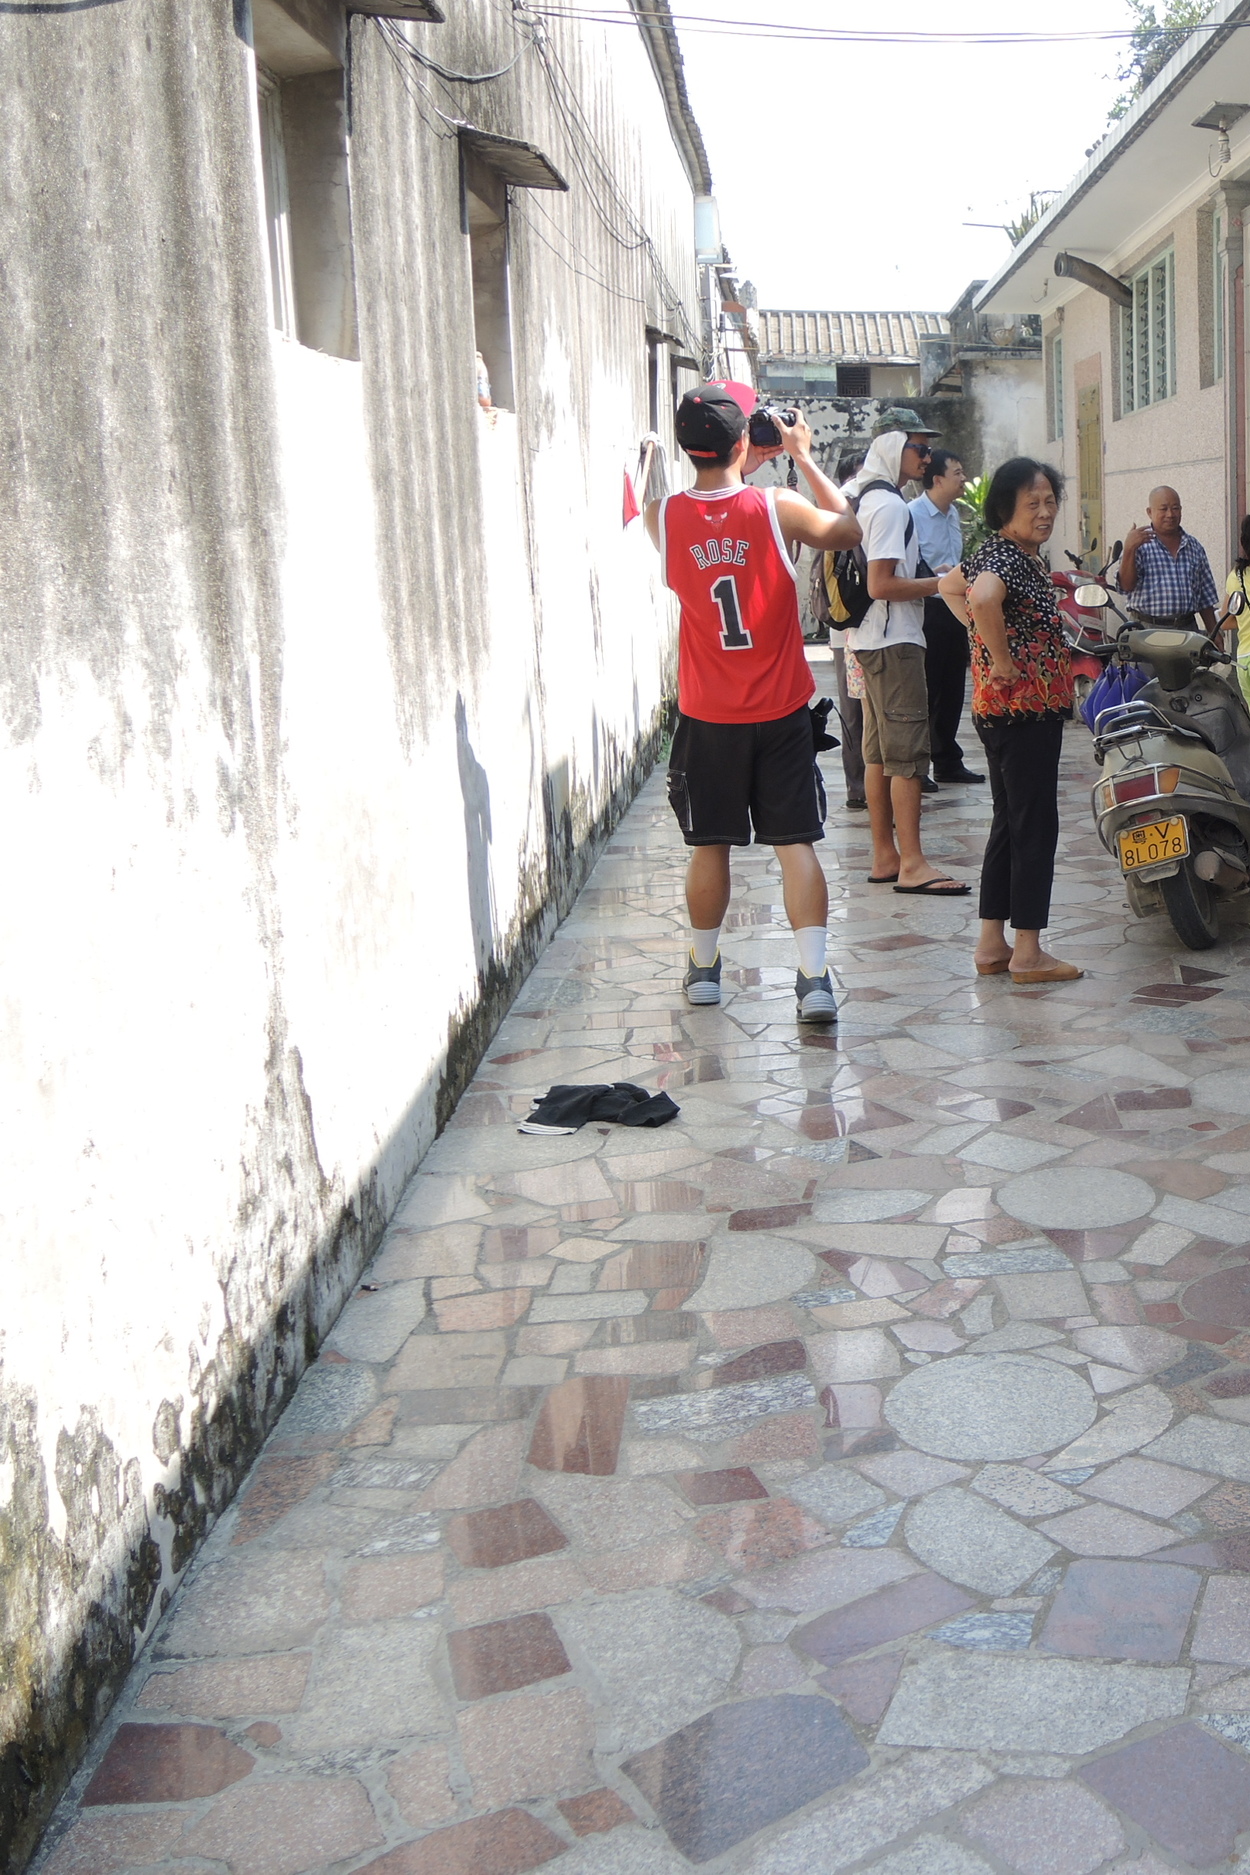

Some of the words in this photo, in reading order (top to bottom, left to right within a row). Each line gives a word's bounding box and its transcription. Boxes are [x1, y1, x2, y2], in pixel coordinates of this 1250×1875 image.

[689, 537, 750, 570] ROSE
[709, 574, 753, 650] 1
[1124, 836, 1182, 867] 8L078
